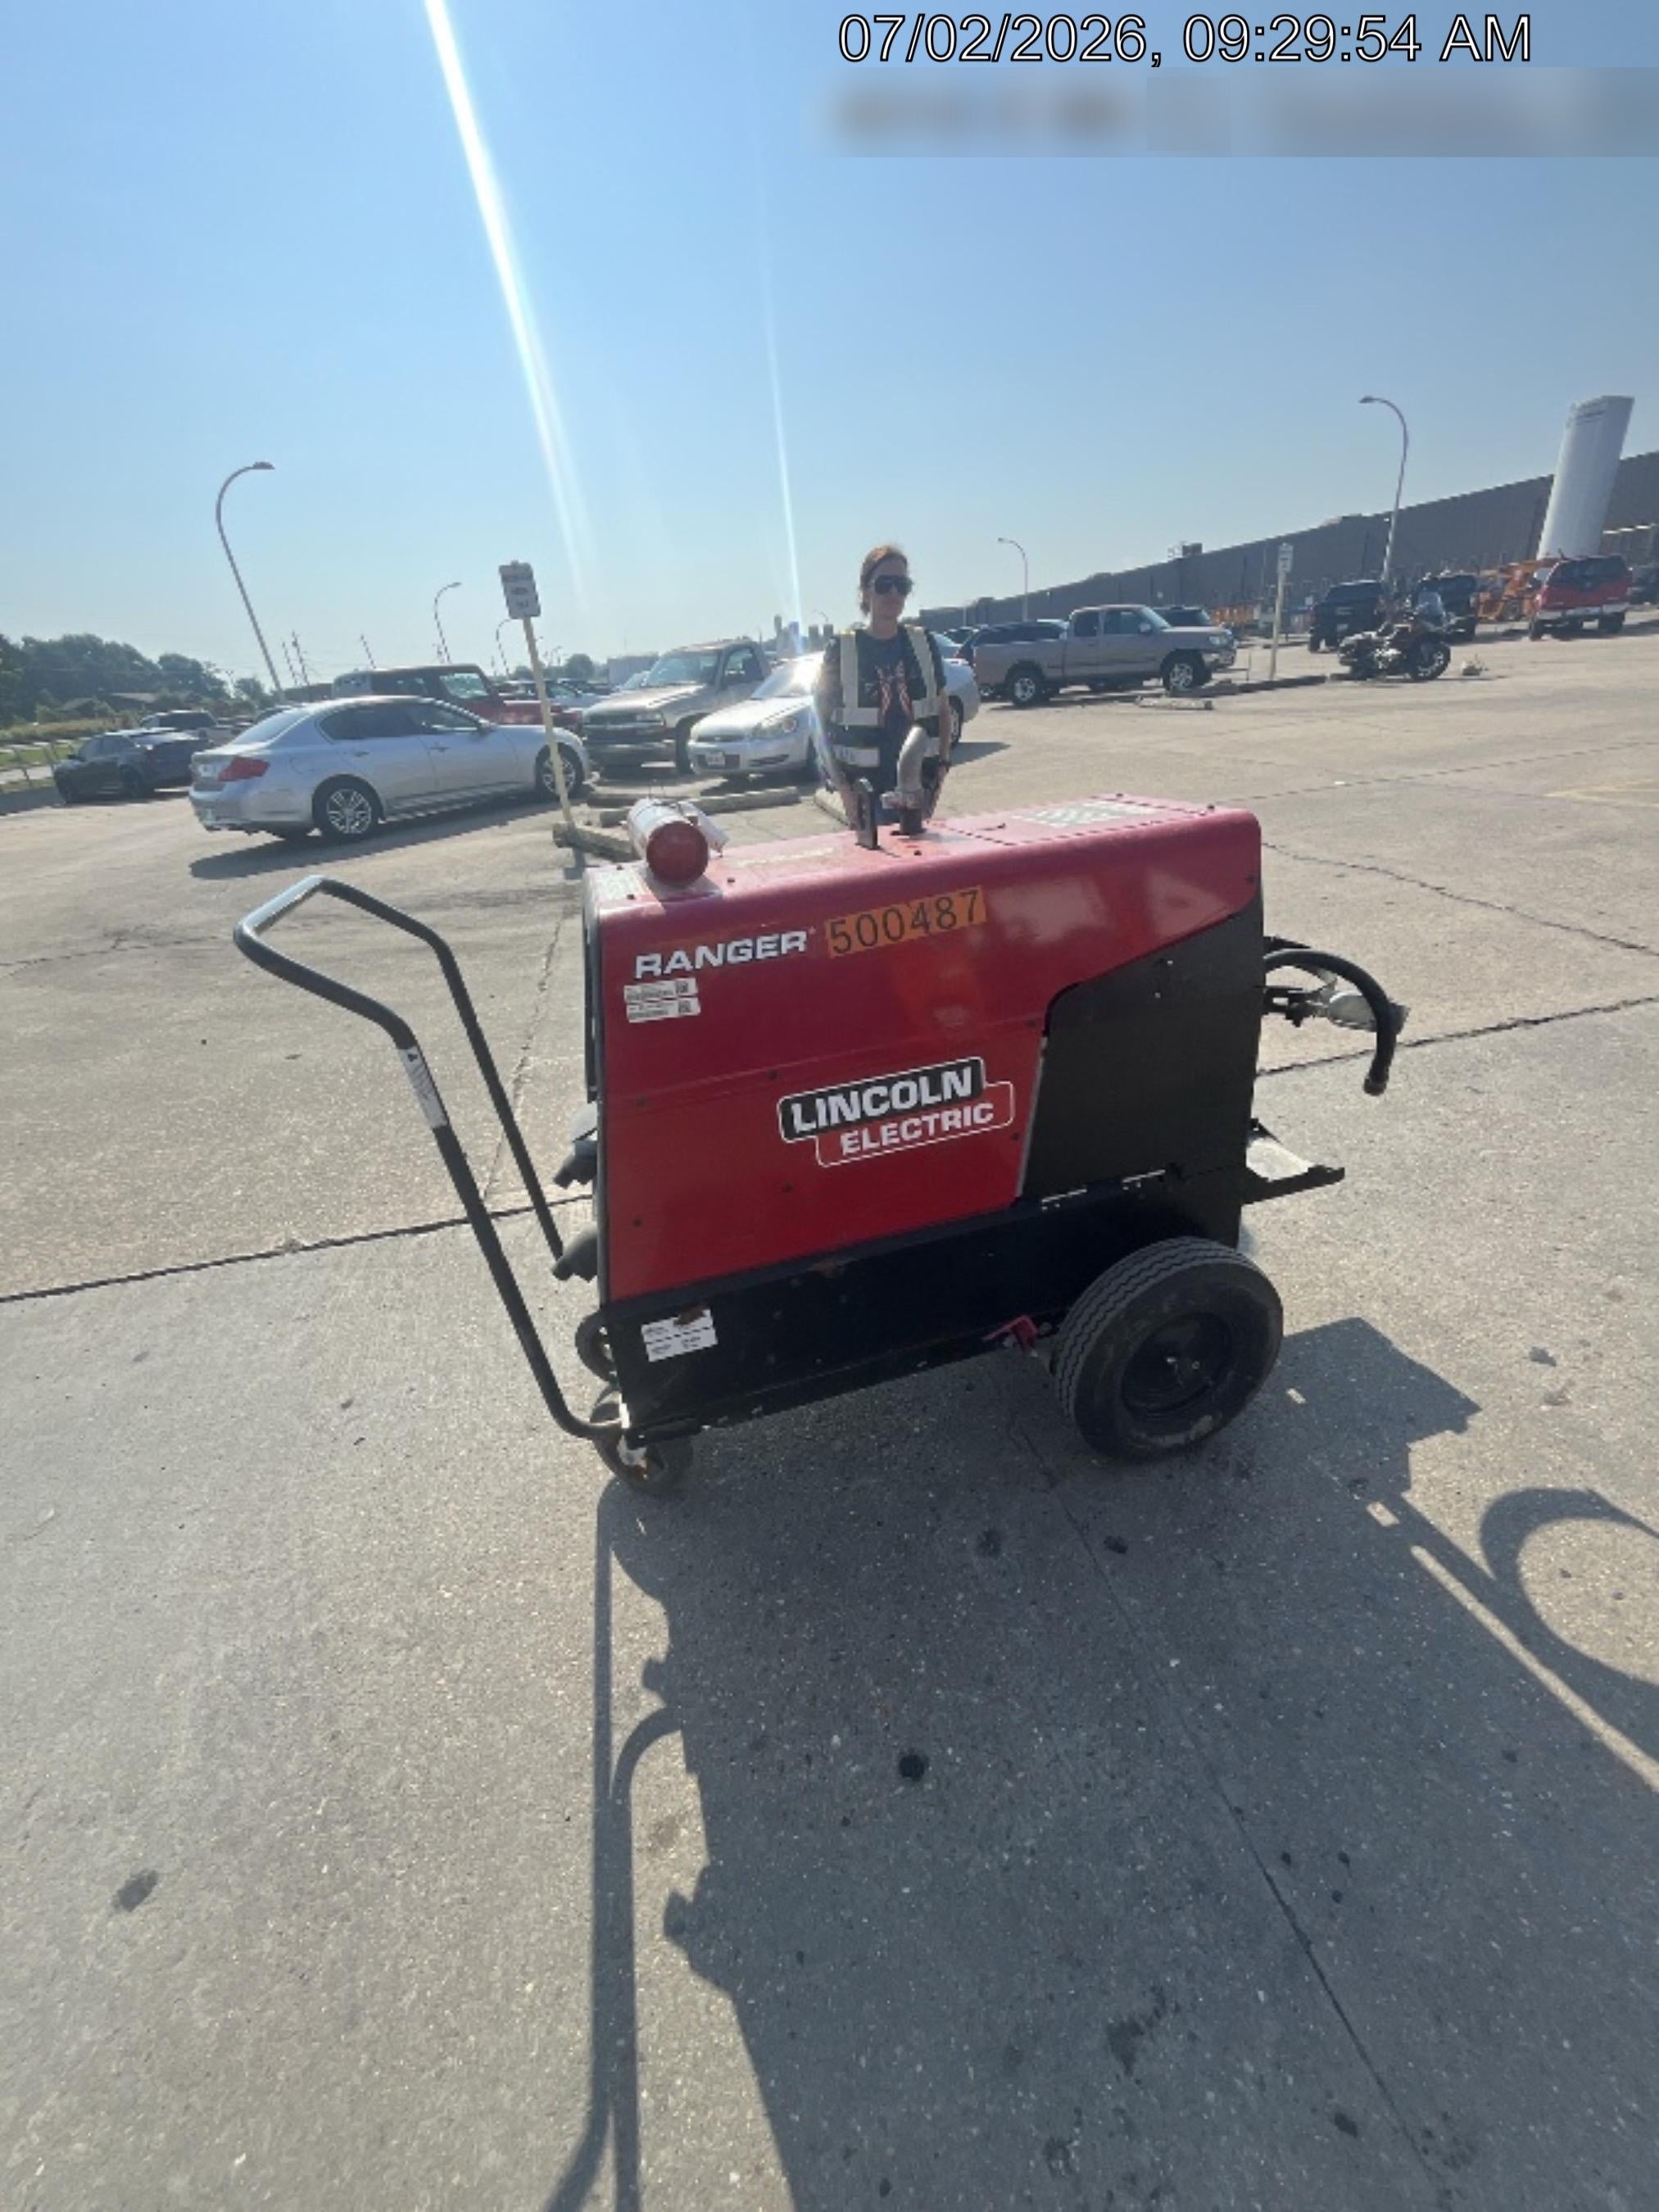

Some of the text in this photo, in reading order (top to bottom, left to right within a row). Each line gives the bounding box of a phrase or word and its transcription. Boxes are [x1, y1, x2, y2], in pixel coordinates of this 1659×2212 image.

[830, 890, 980, 955] 500487
[635, 930, 808, 978] RANGER
[791, 1066, 972, 1132] LINCOLN
[841, 1101, 995, 1156] ELECTRIC
